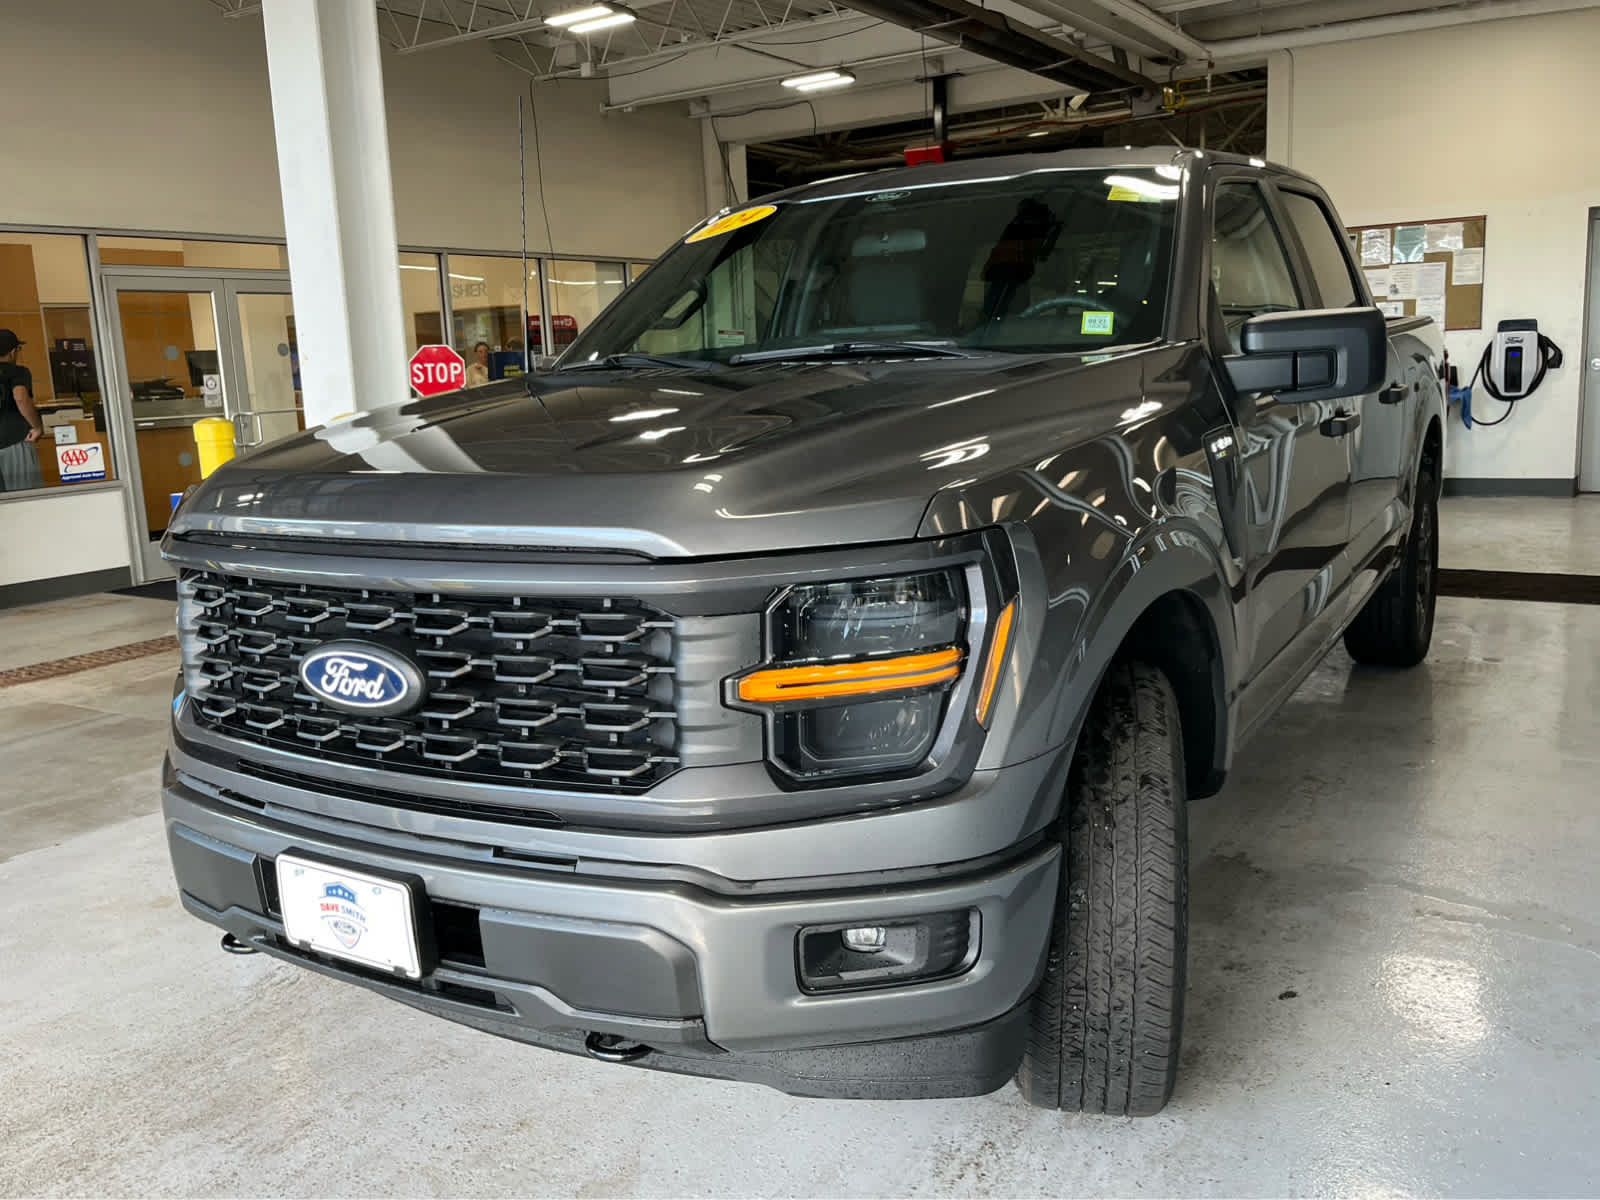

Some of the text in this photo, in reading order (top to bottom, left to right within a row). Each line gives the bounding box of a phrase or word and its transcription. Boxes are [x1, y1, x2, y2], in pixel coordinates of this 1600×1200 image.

[412, 362, 462, 384] STOP
[62, 449, 88, 466] AAA
[321, 658, 385, 700] Ford
[320, 903, 366, 923] DAVE SMITH
